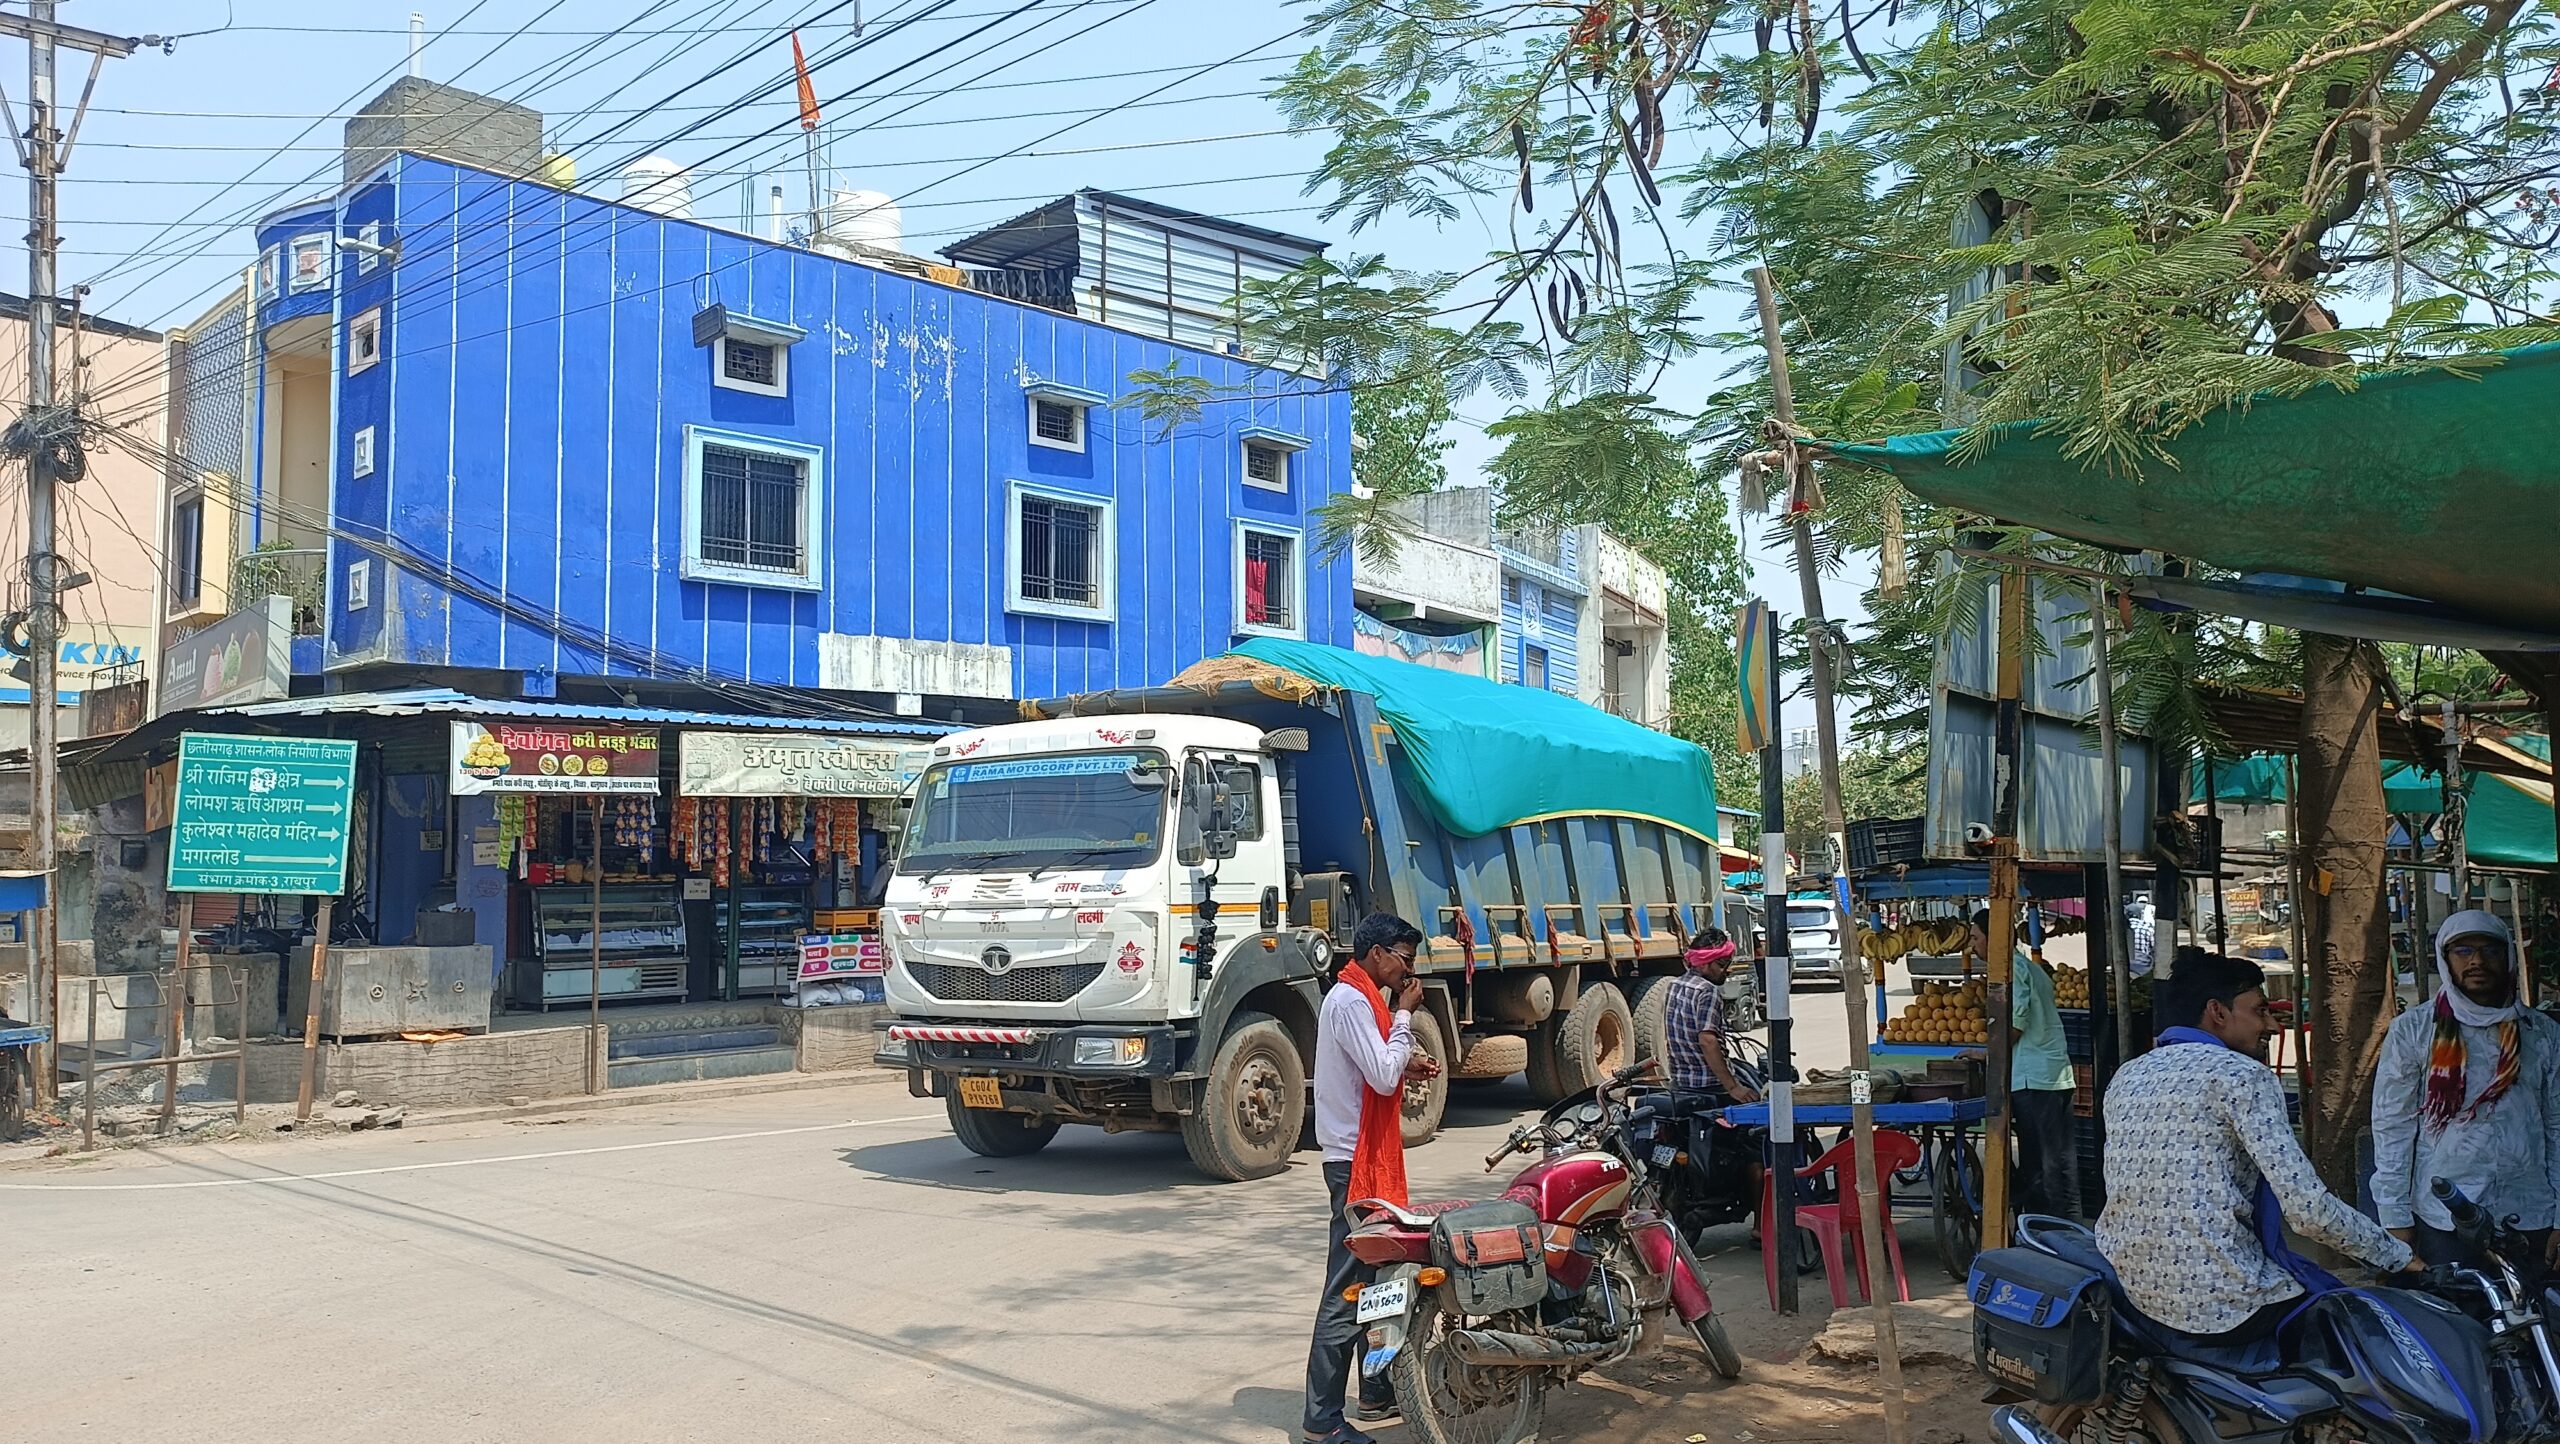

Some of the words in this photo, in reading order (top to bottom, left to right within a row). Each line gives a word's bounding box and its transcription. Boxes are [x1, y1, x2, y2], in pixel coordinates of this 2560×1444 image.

[166, 648, 197, 687] Amul
[501, 726, 572, 751] देवांगन
[572, 732, 596, 749] करी
[629, 733, 658, 750] भंडार
[187, 739, 234, 758] छत्तीसगढ़
[288, 743, 319, 759] निर्माण
[321, 745, 350, 760] विभाग
[743, 745, 815, 775] अमृत
[818, 743, 899, 776] स्वीट्स
[186, 763, 204, 784] श्री
[207, 765, 249, 786] राजिम
[277, 766, 301, 791] क्षेत्र
[972, 768, 1007, 778] RAMA
[1007, 763, 1074, 773] MOTOCORP
[1075, 762, 1101, 770] PVT.
[1102, 760, 1129, 769] LTD.
[803, 775, 835, 792] बेकरी
[838, 776, 855, 792] एवं
[857, 777, 901, 793] नमकीन
[185, 789, 229, 812] लोमश
[182, 816, 234, 843] कुलेश्वर
[236, 818, 281, 842] महादेव
[284, 822, 318, 843] मंदिर
[181, 844, 241, 865] मगरलोड
[198, 872, 233, 885] संभाग
[979, 922, 1010, 933] TATA
[1229, 1035, 1255, 1071] apollo
[1601, 1161, 1620, 1172] TVS
[1380, 1292, 1404, 1308] 5620
